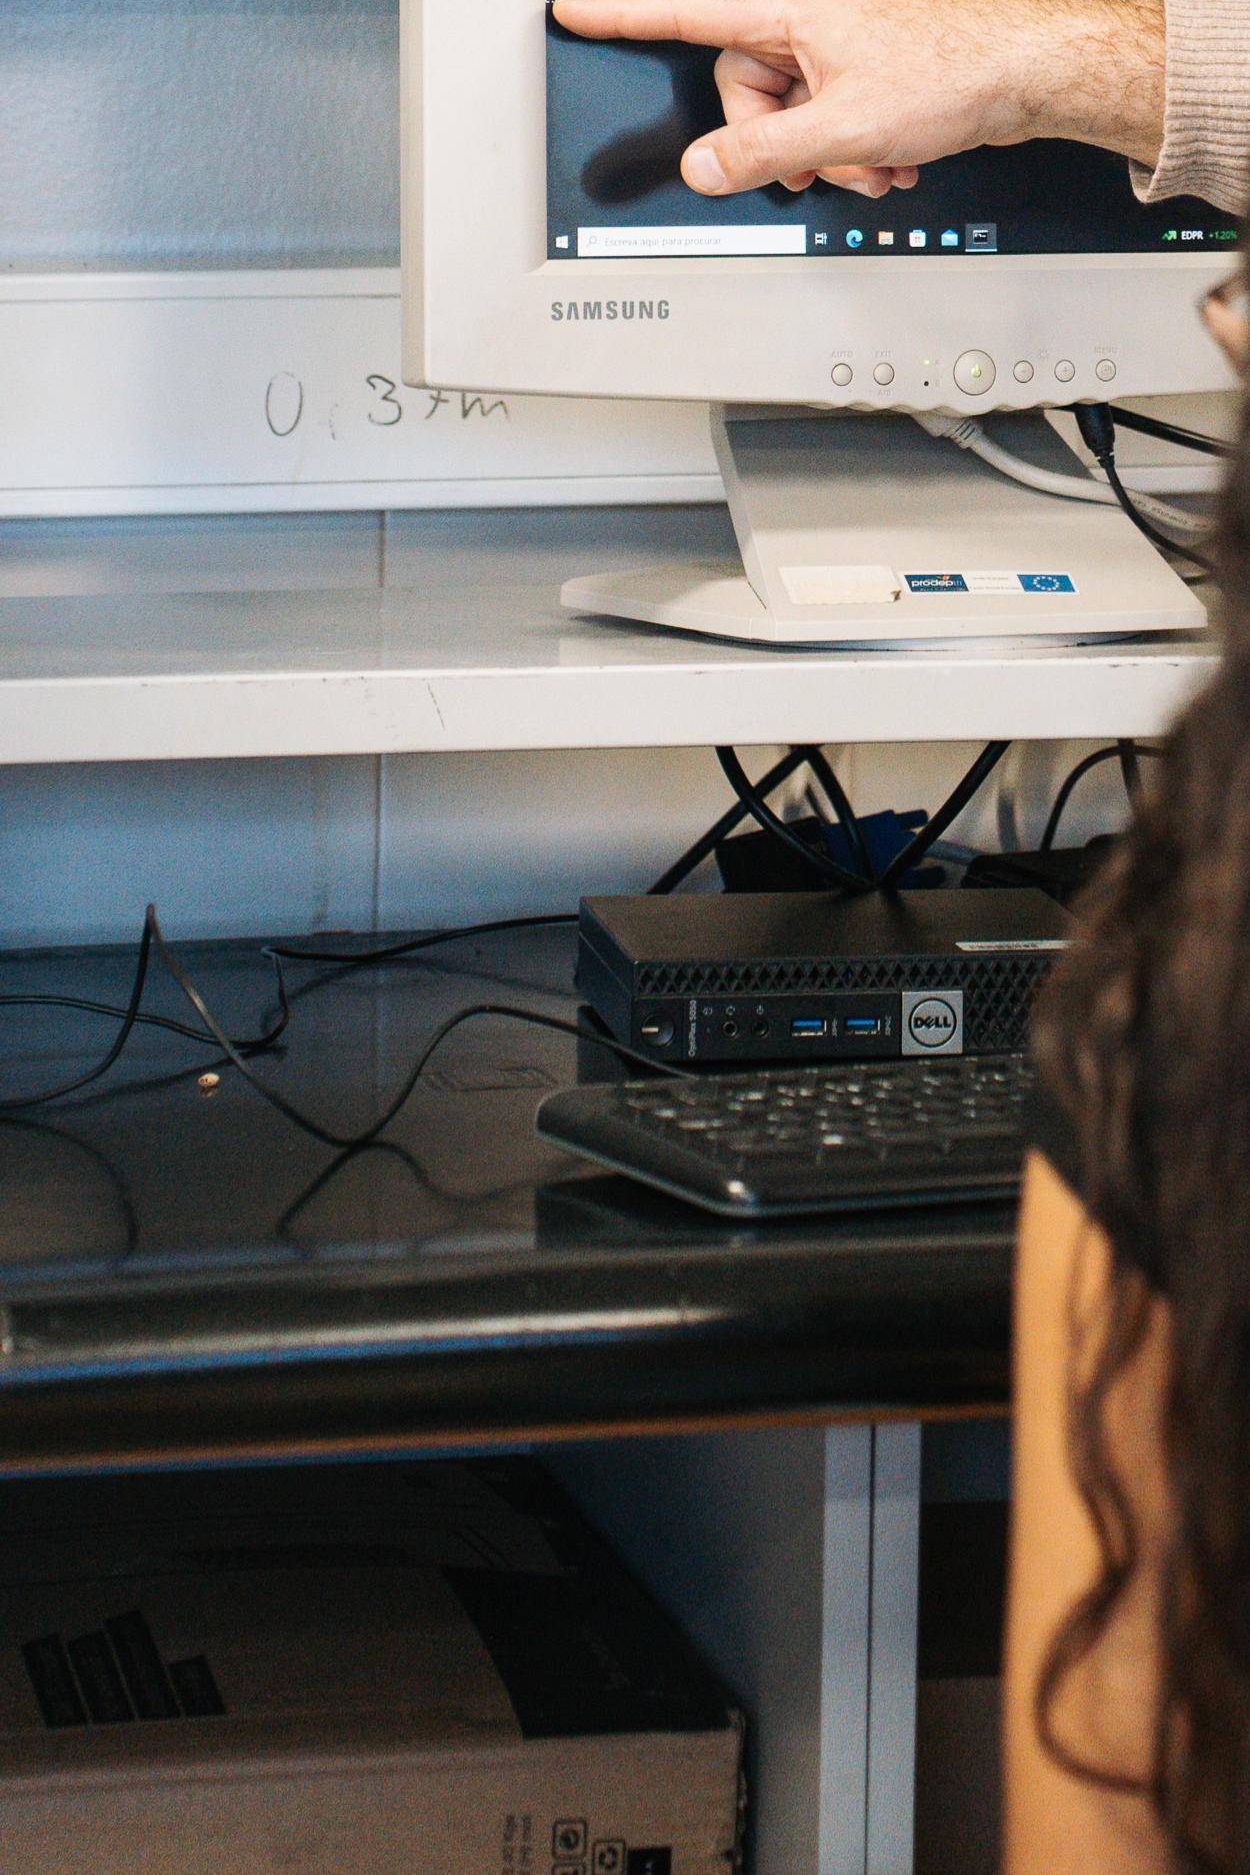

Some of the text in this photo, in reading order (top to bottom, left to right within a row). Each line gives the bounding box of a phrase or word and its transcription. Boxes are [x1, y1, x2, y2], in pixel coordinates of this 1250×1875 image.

[1181, 230, 1204, 240] EDPR
[605, 237, 721, 248] Escreva aqui para procurar
[551, 300, 670, 321] SAMSUNG
[914, 1016, 951, 1029] DELL
